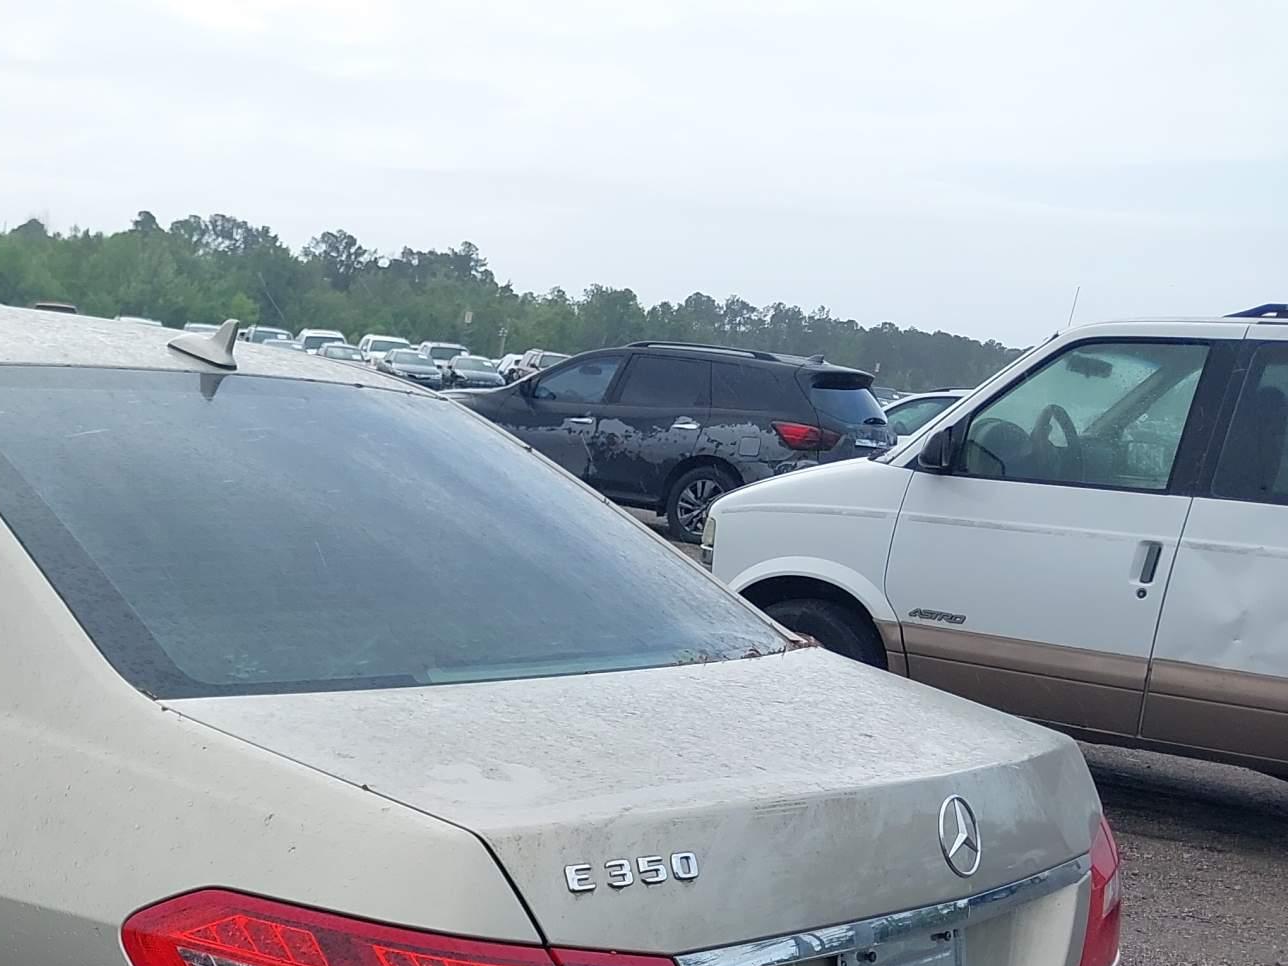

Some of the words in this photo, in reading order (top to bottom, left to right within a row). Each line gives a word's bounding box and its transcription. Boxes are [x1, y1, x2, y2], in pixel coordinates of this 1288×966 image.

[908, 608, 966, 624] ASTRO
[564, 864, 596, 892] E
[604, 852, 699, 887] 350
